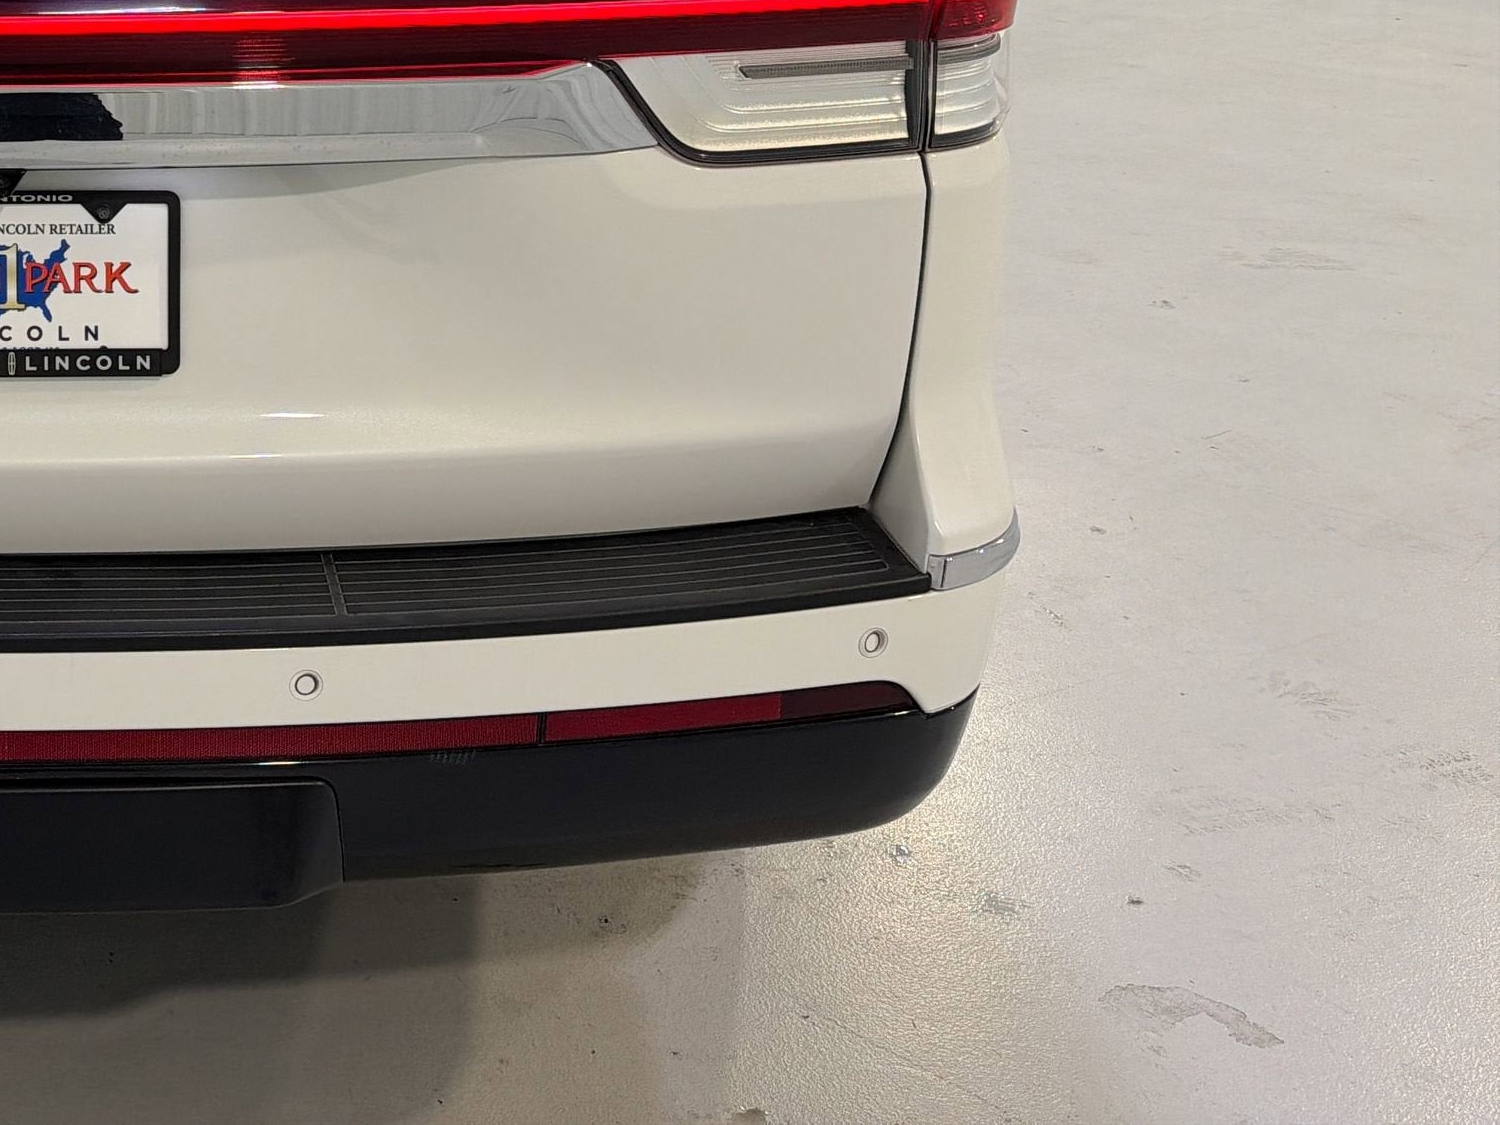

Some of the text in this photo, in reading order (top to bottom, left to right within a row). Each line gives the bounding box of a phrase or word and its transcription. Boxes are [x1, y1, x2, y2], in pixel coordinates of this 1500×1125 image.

[49, 224, 116, 235] RETAILER
[24, 261, 139, 294] PARK
[25, 355, 151, 371] LINCOLN
